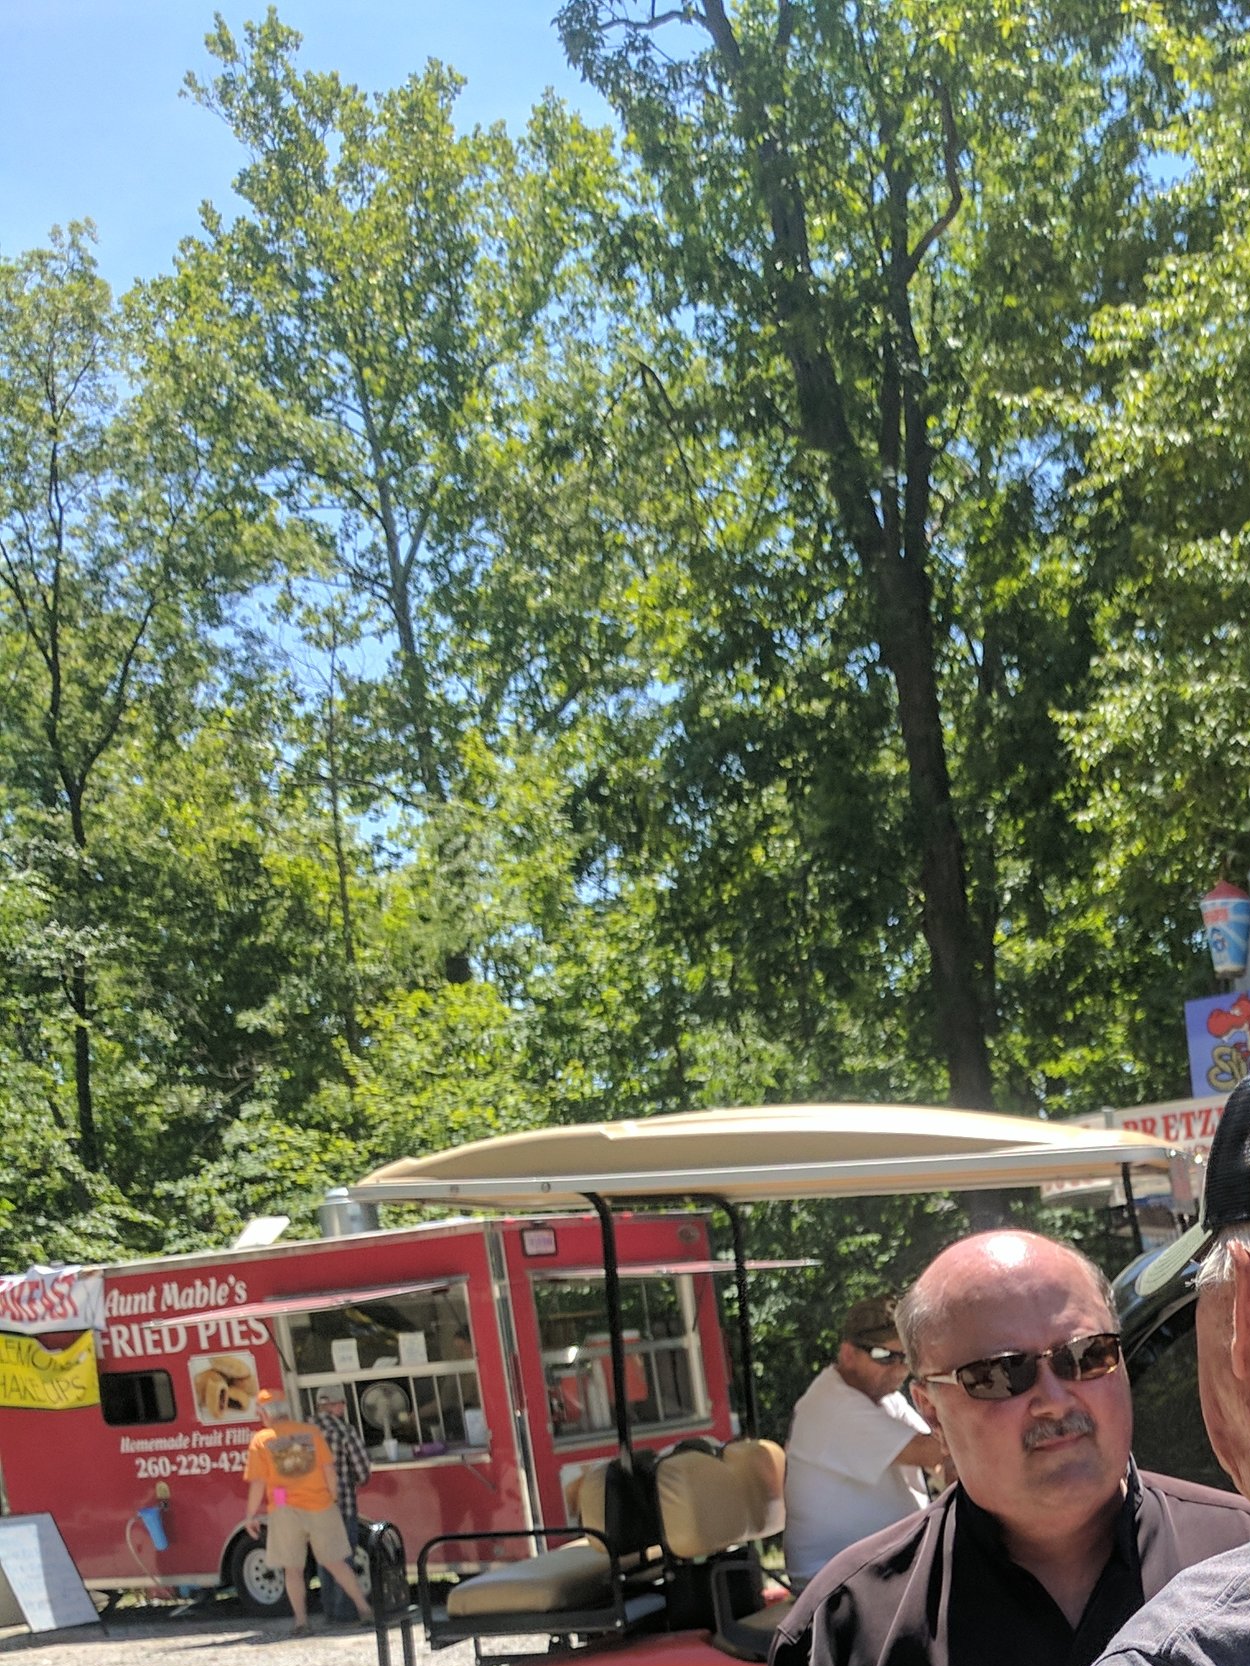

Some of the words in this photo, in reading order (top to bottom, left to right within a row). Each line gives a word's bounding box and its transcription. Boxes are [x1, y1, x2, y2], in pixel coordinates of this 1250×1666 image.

[105, 1284, 157, 1318] Aunt
[160, 1274, 248, 1312] Mable's
[197, 1317, 271, 1351] PIES
[120, 1432, 190, 1455] Homemade
[191, 1430, 223, 1449] Fruit
